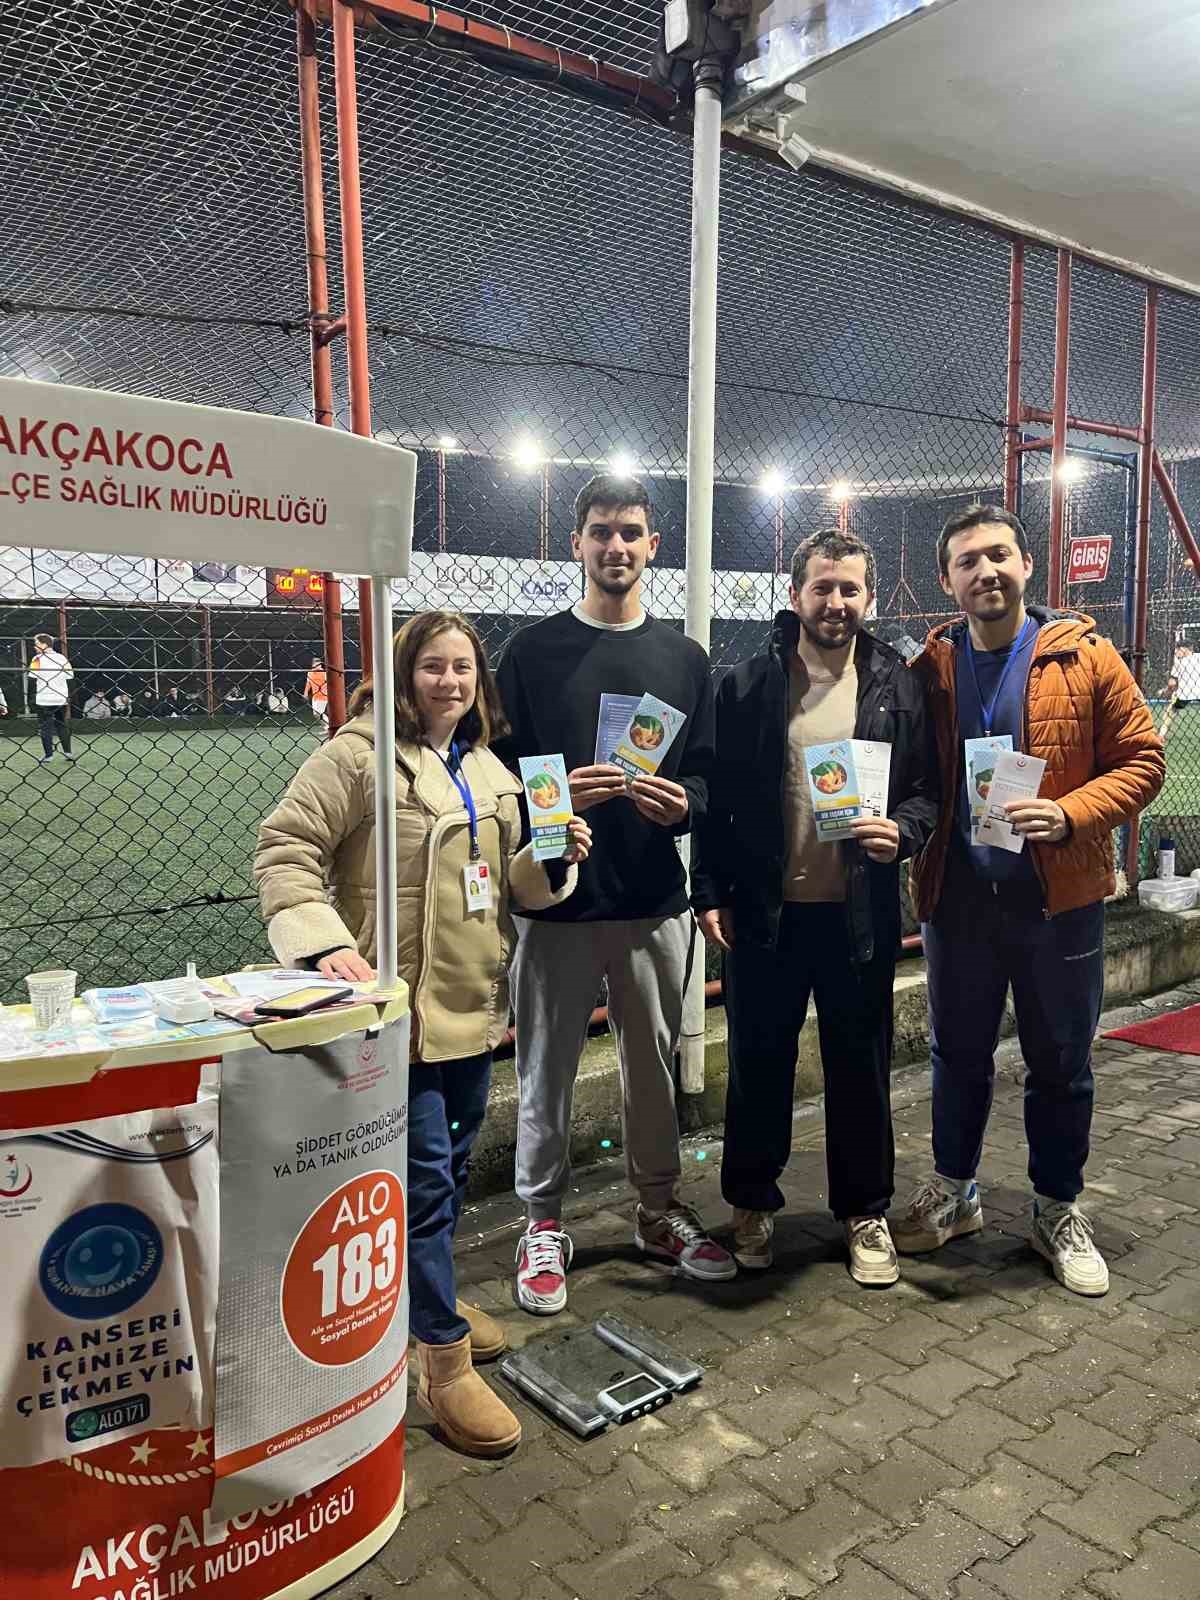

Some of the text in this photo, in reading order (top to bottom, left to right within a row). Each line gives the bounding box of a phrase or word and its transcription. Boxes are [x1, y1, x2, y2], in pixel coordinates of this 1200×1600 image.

[60, 475, 162, 511] SAĞLIK
[170, 485, 327, 526] MÜDÜRLÜĞÜ
[1072, 543, 1108, 569] GİRİŞ
[273, 1162, 292, 1179] YA
[296, 1158, 317, 1174] DA
[320, 1145, 358, 1168] TANIK
[296, 1132, 342, 1158] ŞİDDET
[331, 1181, 390, 1234] ALO
[312, 1217, 397, 1318] 183
[26, 1308, 181, 1361] KANSERİ
[310, 1326, 325, 1337] Aile
[320, 1324, 350, 1345] Sosyal
[351, 1310, 378, 1330] Destek
[43, 1338, 168, 1384] İÇİNİZE
[16, 1355, 194, 1417] ÇEKMEYİN
[99, 1403, 145, 1431] ALO 171
[305, 1416, 331, 1438] Sosyal
[205, 1485, 355, 1583] MÜDÜRLÜĞÜ
